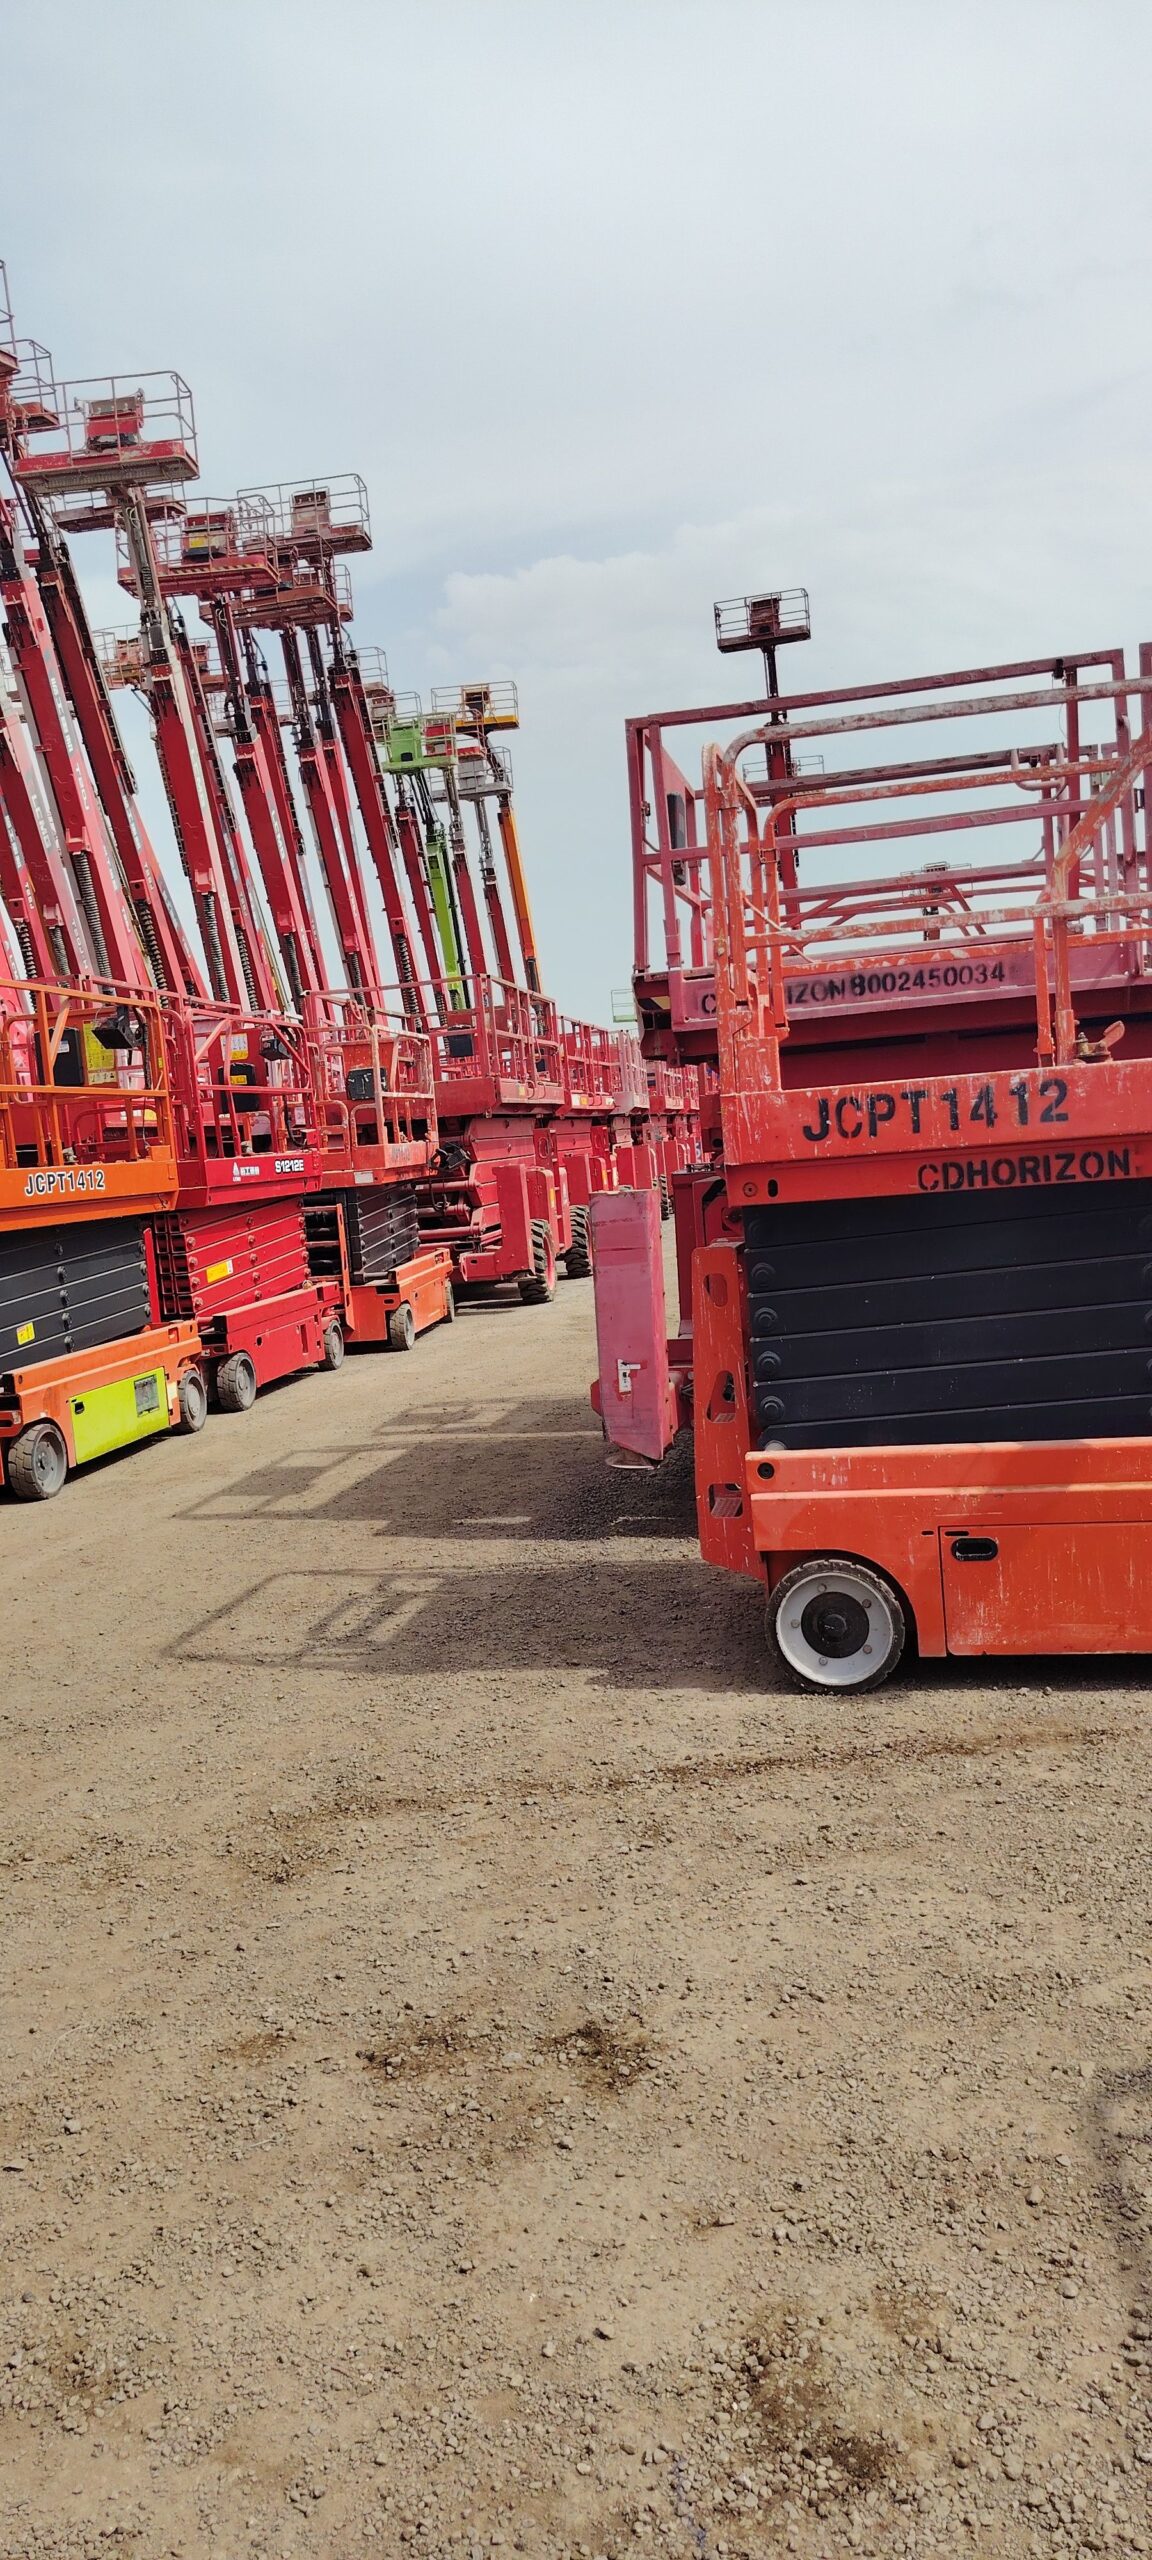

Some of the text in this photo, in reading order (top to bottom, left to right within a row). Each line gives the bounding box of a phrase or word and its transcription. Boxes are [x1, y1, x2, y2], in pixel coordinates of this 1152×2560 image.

[803, 1079, 1070, 1142] JCPT1412
[24, 1169, 106, 1197] JCPT1412
[274, 1158, 305, 1175] S1212E
[917, 1149, 1130, 1192] CDHORIZON
